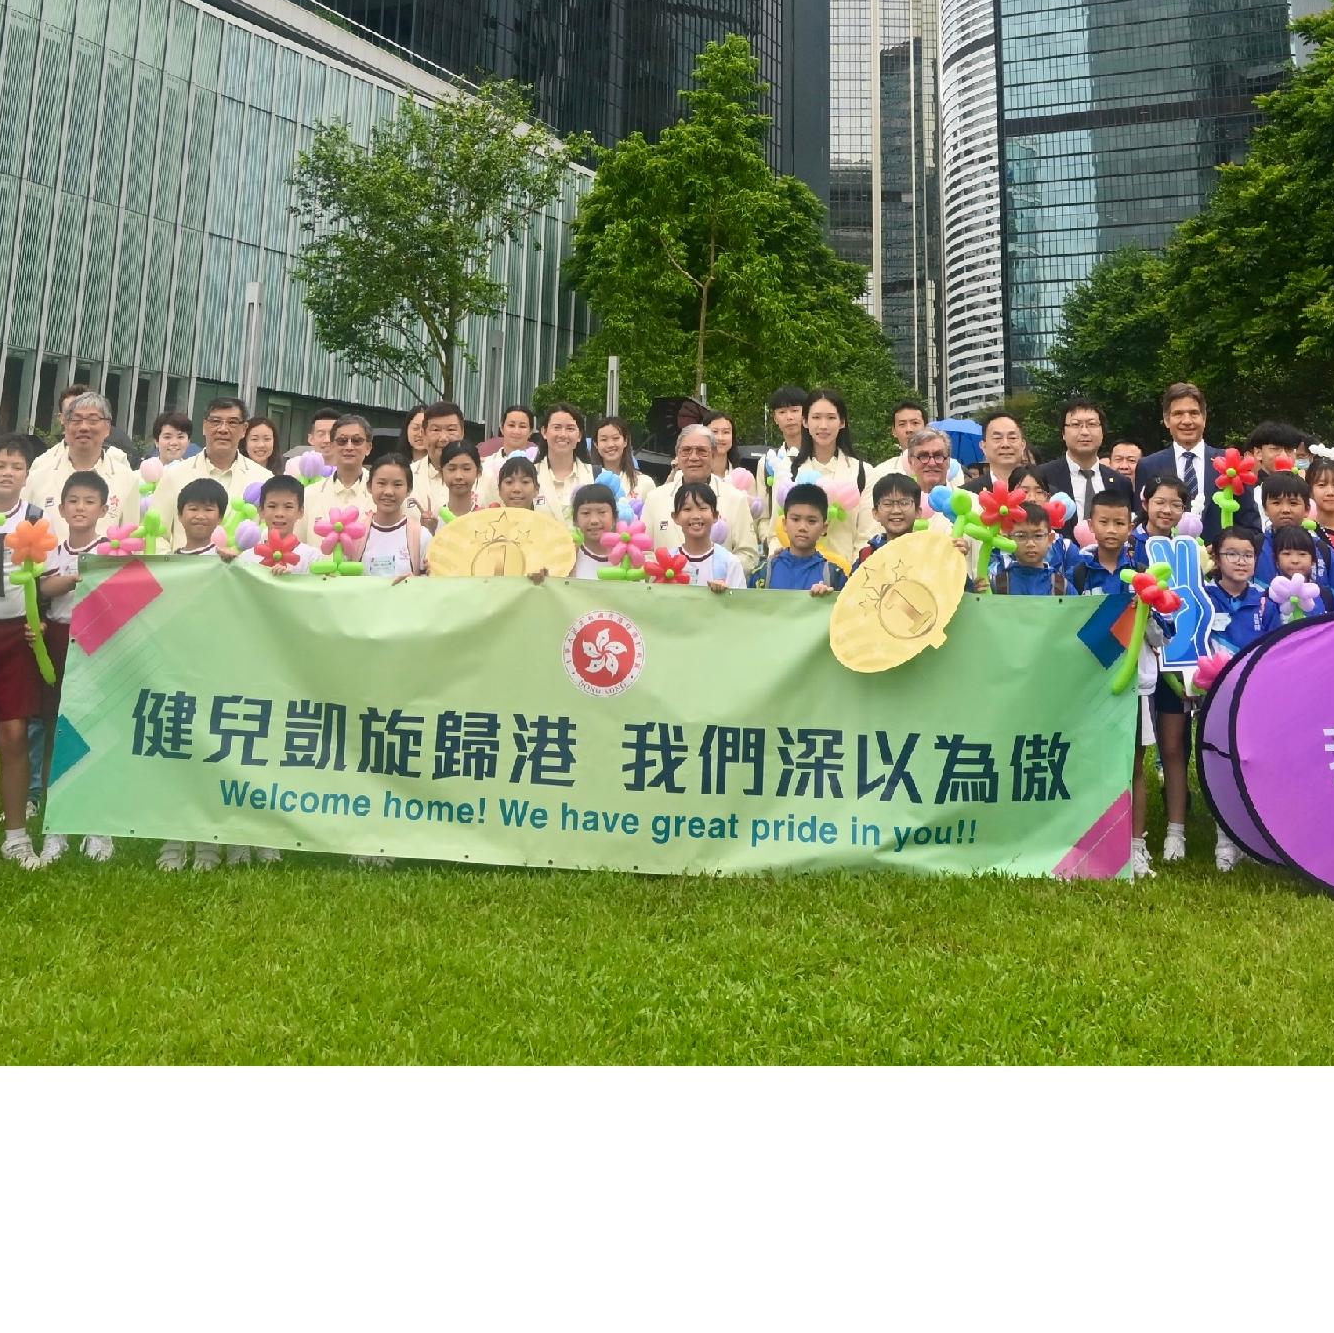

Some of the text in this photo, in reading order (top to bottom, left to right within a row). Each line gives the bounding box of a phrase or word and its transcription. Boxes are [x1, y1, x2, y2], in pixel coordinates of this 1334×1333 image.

[131, 688, 1072, 804] 健兒凱旋歸港 我們深以為傲
[219, 779, 977, 853] Welcome home! We have great pride in you!!
